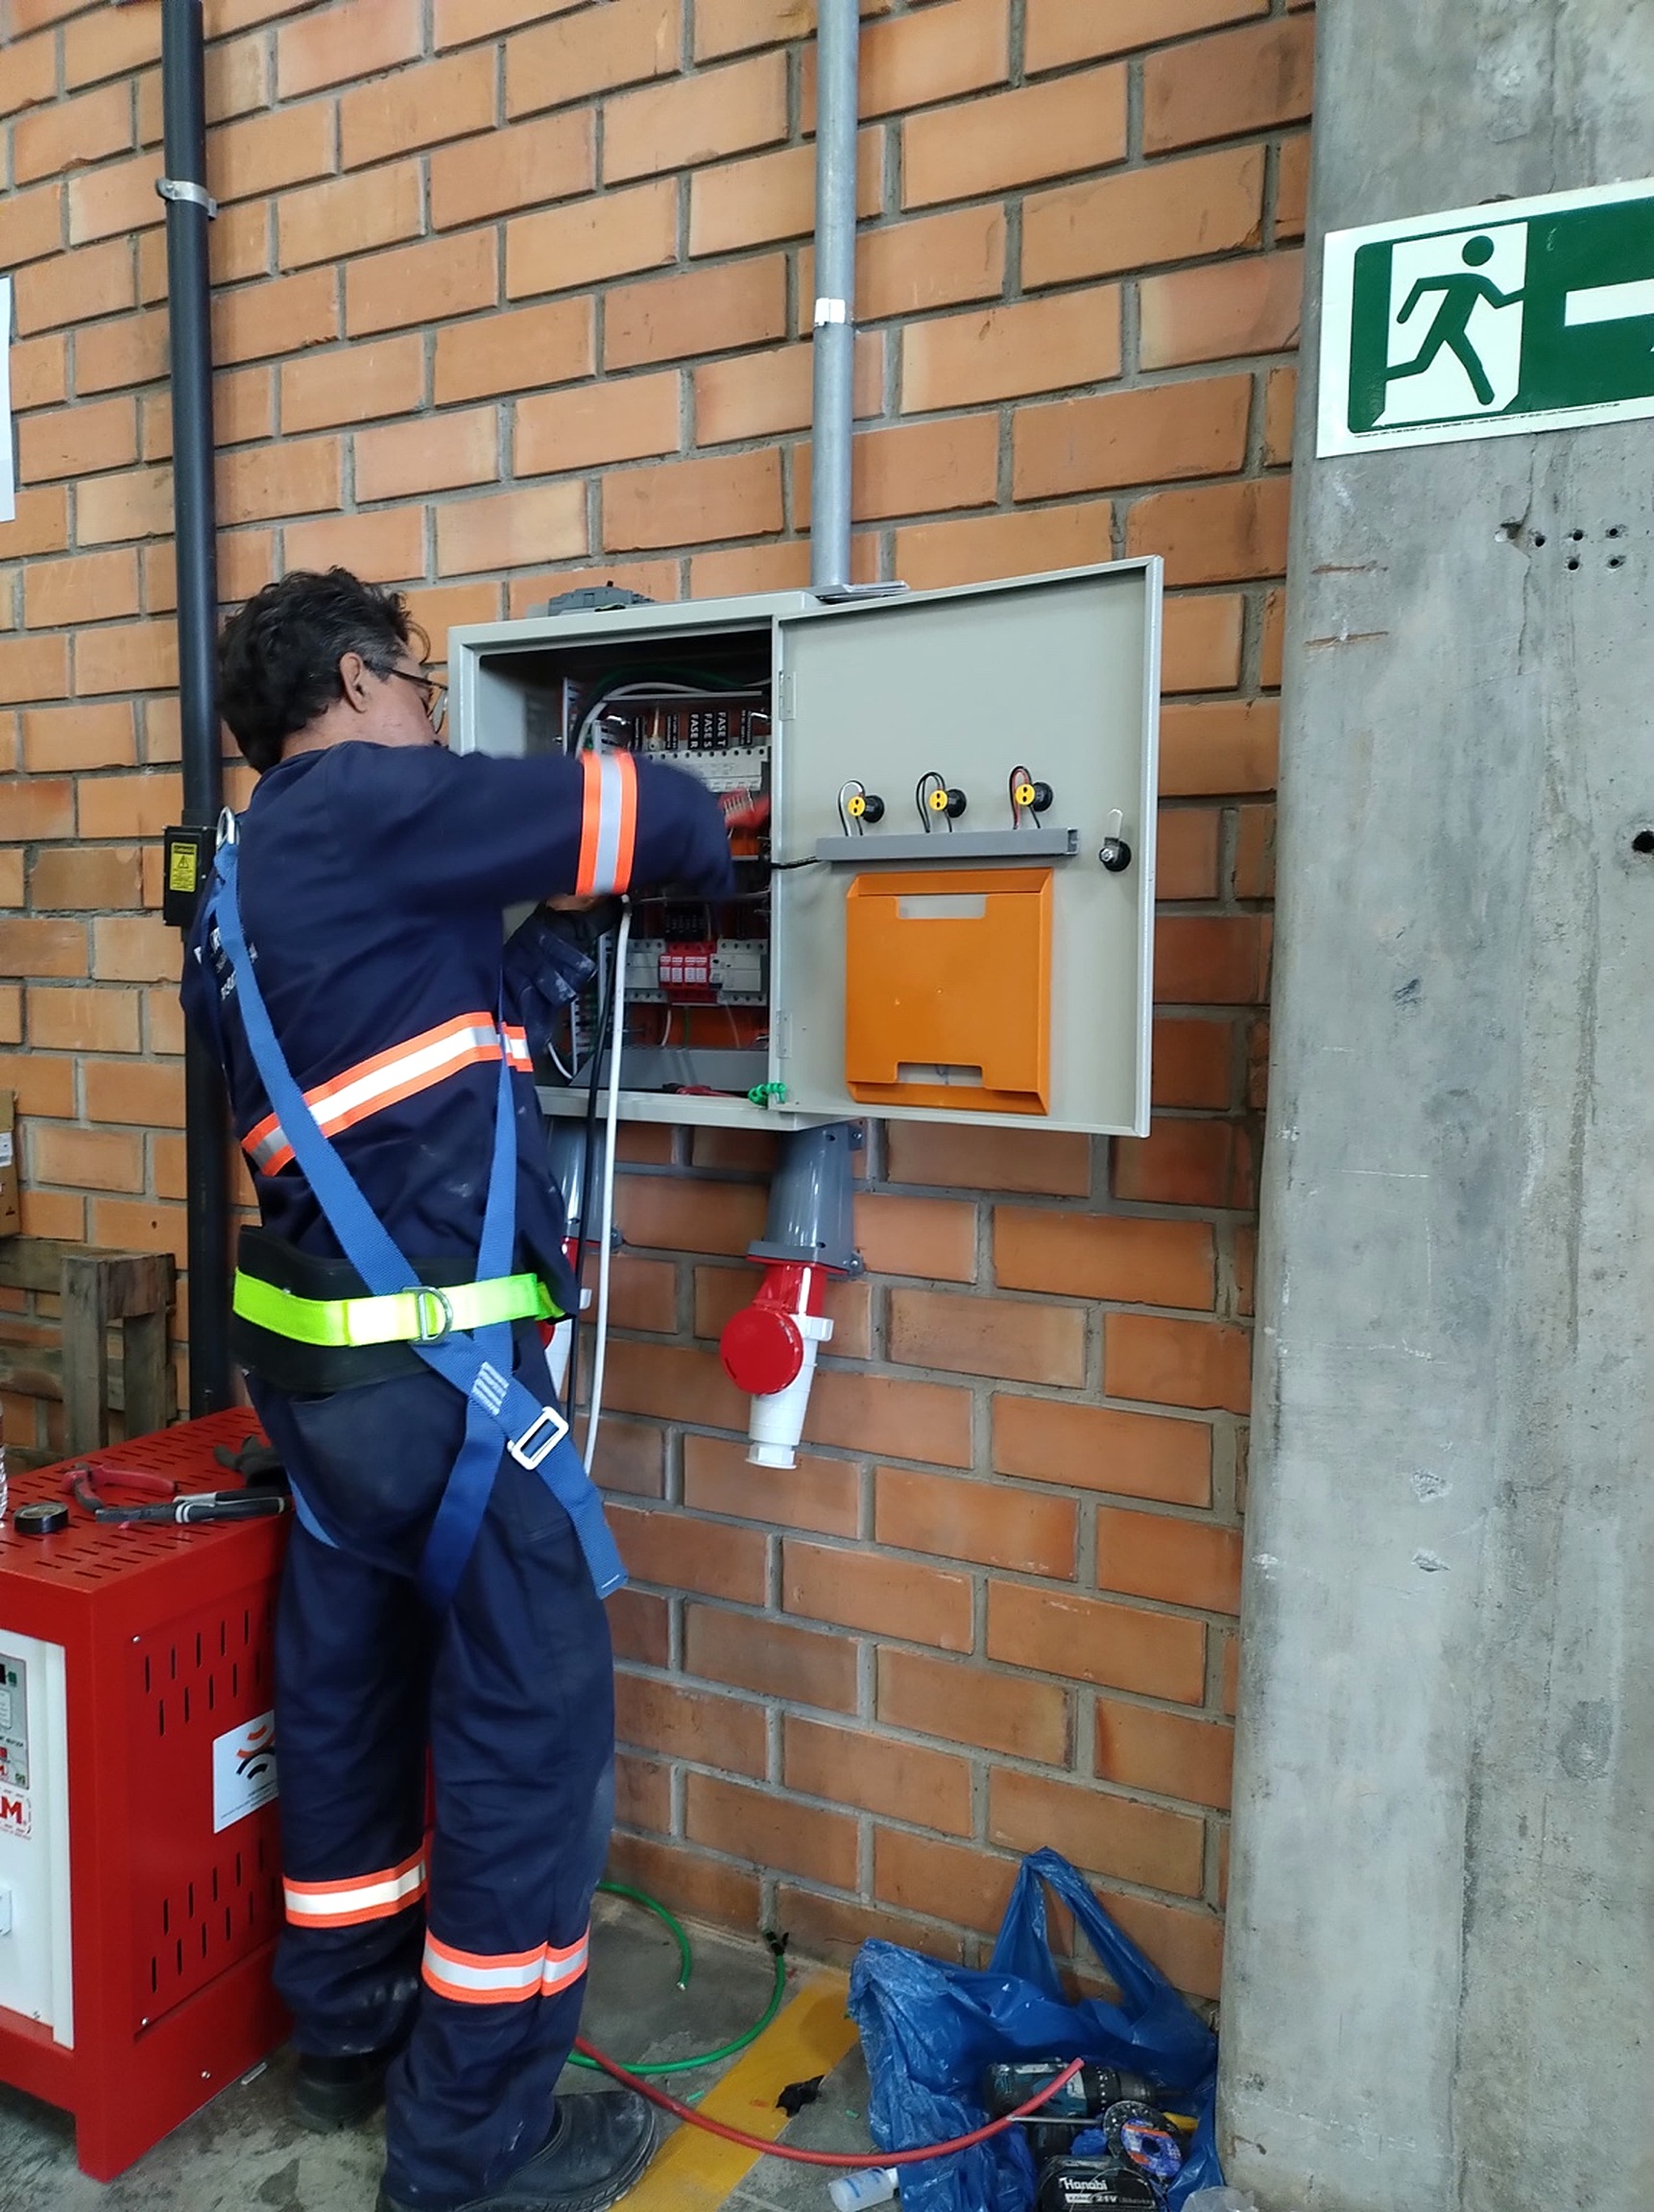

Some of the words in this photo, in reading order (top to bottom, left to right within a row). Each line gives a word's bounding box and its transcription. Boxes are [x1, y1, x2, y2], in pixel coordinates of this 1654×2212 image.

[690, 713, 700, 738] FASE
[704, 712, 713, 738] FASE
[717, 711, 727, 737] FASE
[690, 740, 699, 749] R
[1061, 2177, 1108, 2190] Hanabi
